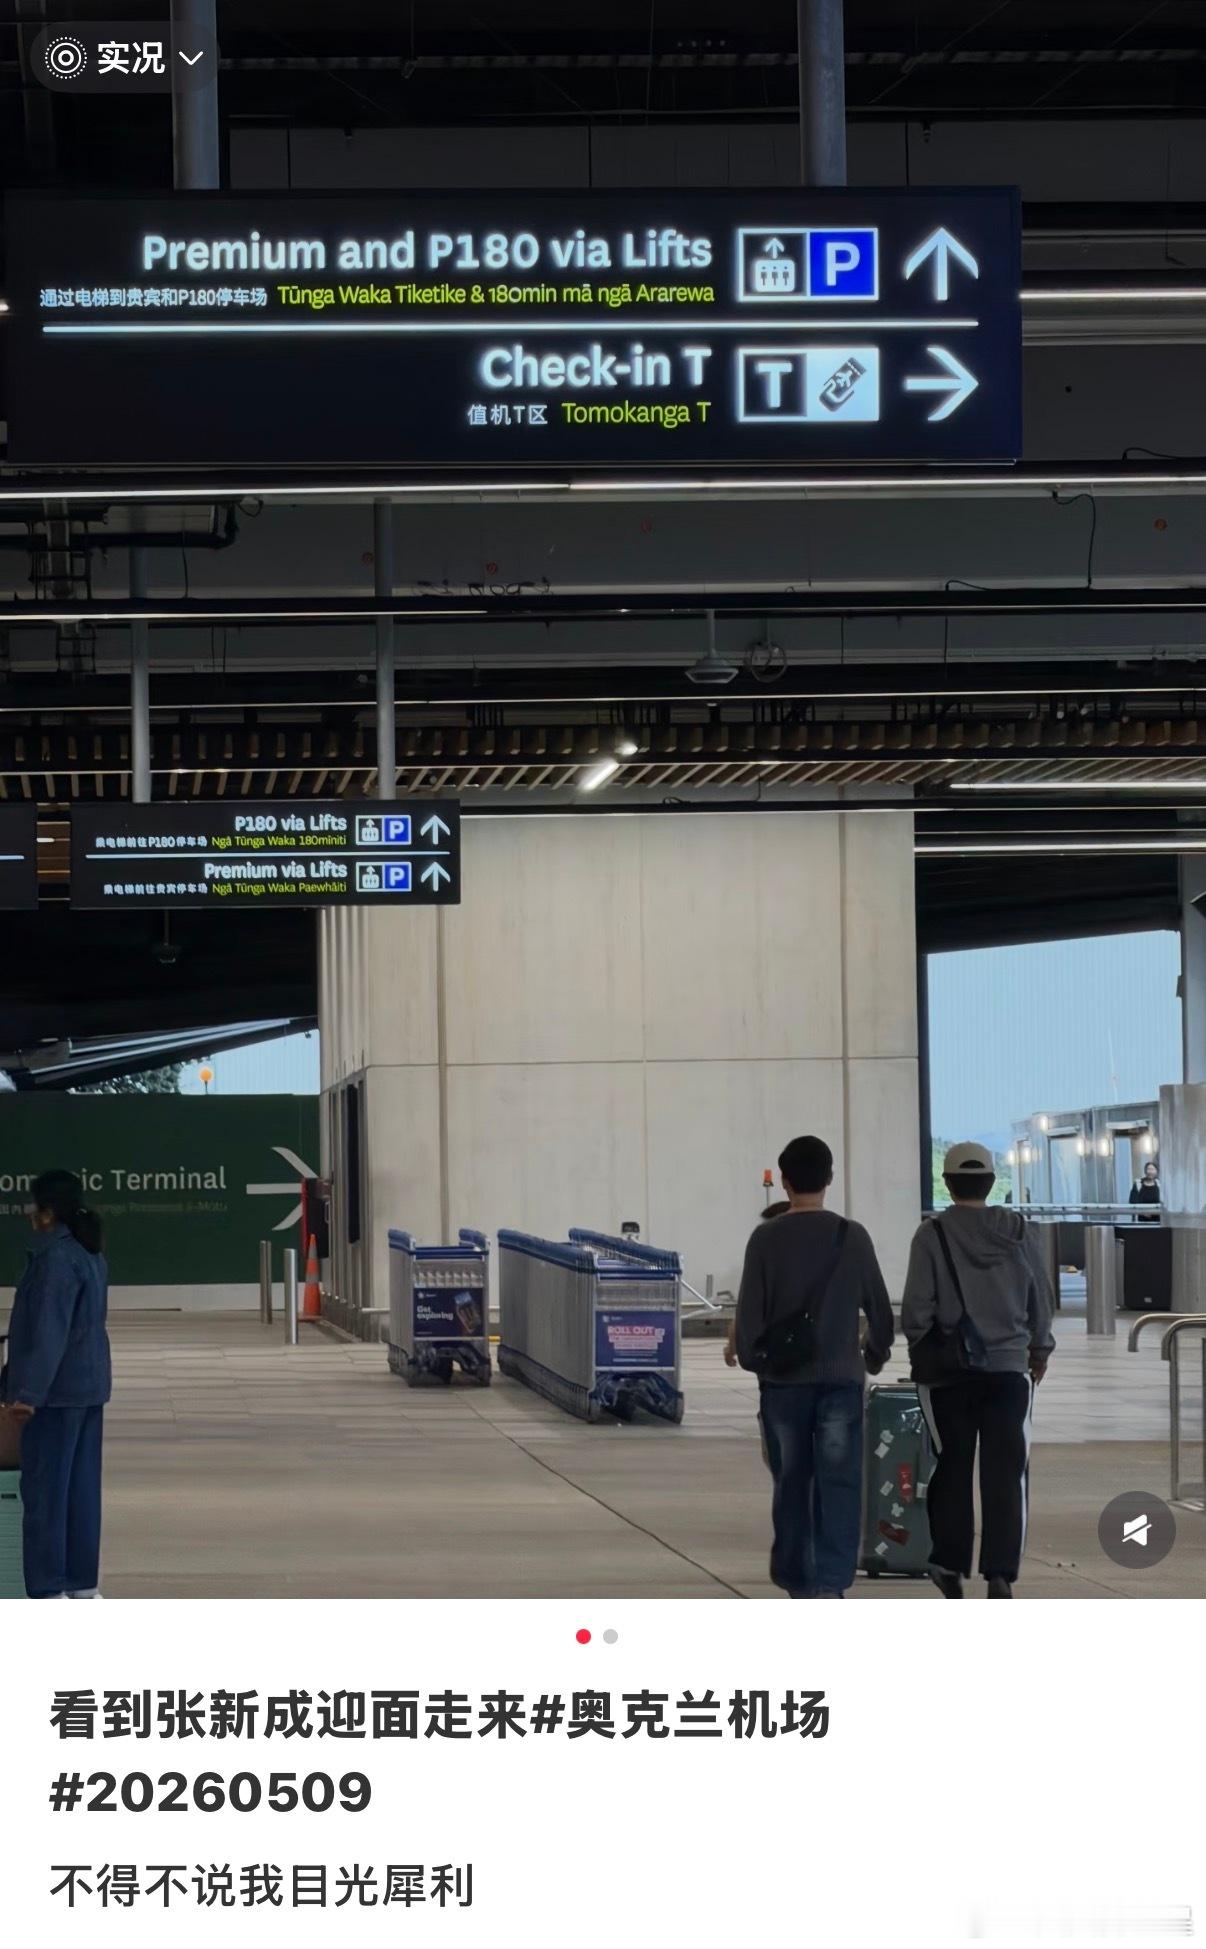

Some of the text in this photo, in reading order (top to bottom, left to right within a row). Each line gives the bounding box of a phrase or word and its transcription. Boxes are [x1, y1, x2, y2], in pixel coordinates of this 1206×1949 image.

[143, 229, 712, 270] Premium and P180 via Lifts
[826, 242, 860, 287] P
[39, 288, 267, 308] 通过电梯到贵宾和P180停车场
[277, 284, 714, 309] Tūnga Waka Tiketike & 180min mā ngā Ararewa
[480, 344, 712, 388] Check-in T
[756, 361, 793, 408] T
[467, 404, 548, 426] 值机T区
[561, 400, 711, 428] Tomokanga T
[235, 814, 347, 832] P180 via Lifts
[390, 821, 405, 840] P
[268, 835, 295, 846] Waka
[205, 860, 347, 879] Premium via Lifts
[390, 868, 405, 887] P
[268, 882, 295, 893] Waka
[111, 1166, 226, 1190] Terminal
[633, 1326, 654, 1335] OUT
